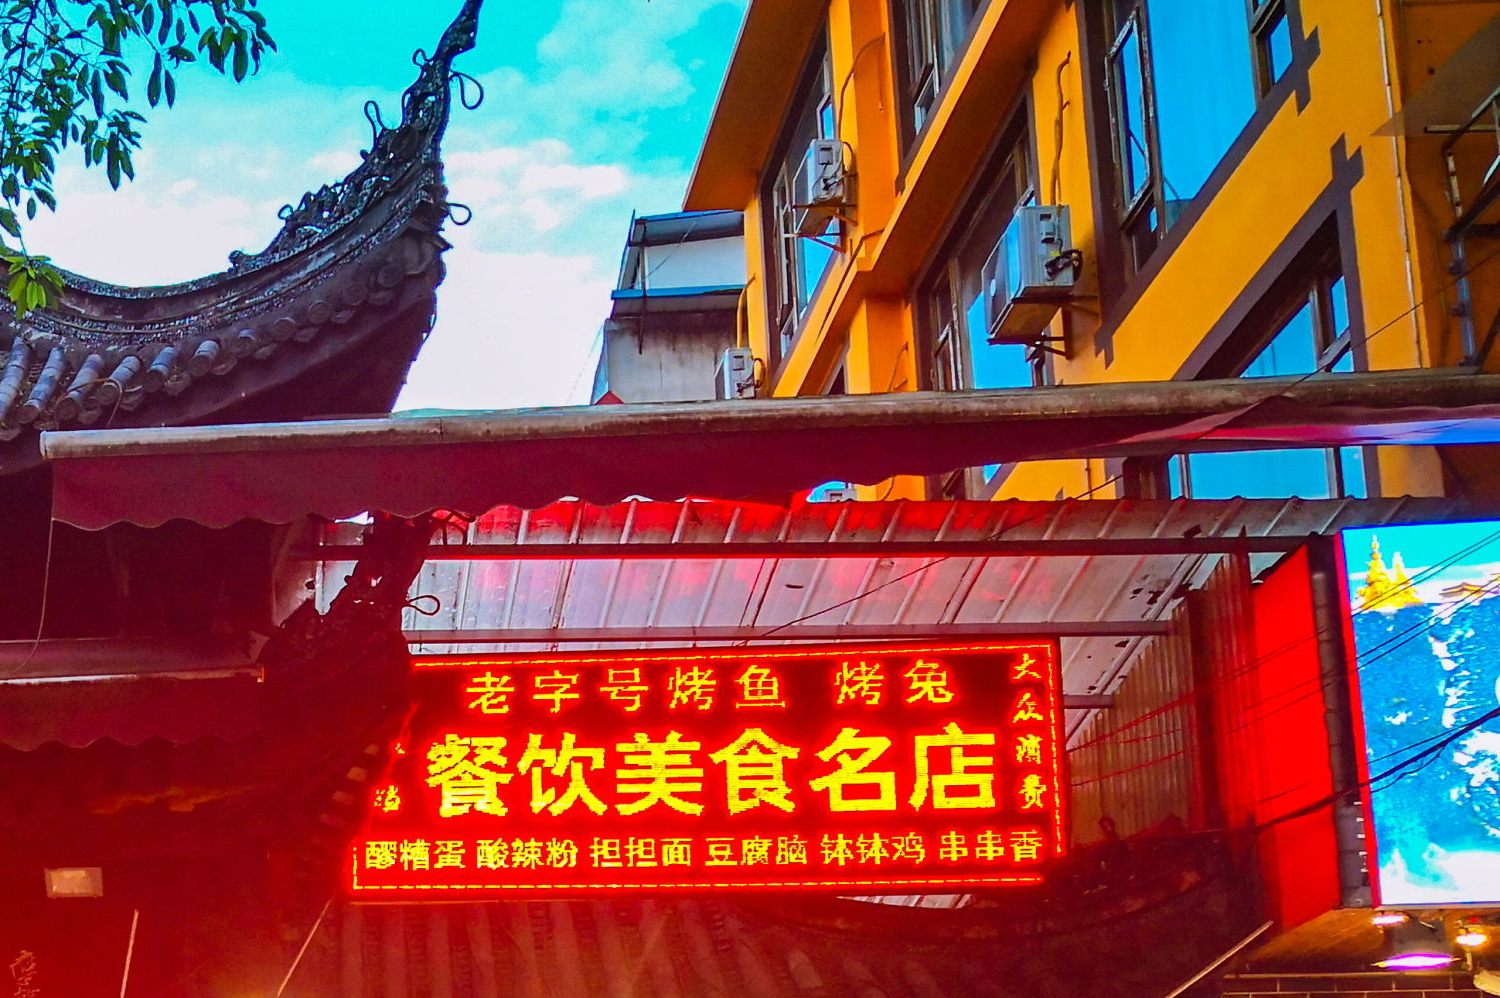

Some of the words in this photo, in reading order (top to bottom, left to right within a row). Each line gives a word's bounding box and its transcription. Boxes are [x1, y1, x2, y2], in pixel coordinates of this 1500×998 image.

[466, 665, 786, 714] 老字号烤鱼
[834, 659, 954, 705] 烤兔
[425, 722, 996, 818] 餐饮美食名店
[476, 838, 579, 870] 酸辣粉
[589, 837, 694, 868] 担担面
[705, 834, 808, 866] 豆腐脑
[820, 832, 926, 866] 钵钵鸡
[939, 830, 1043, 863] 串串香
